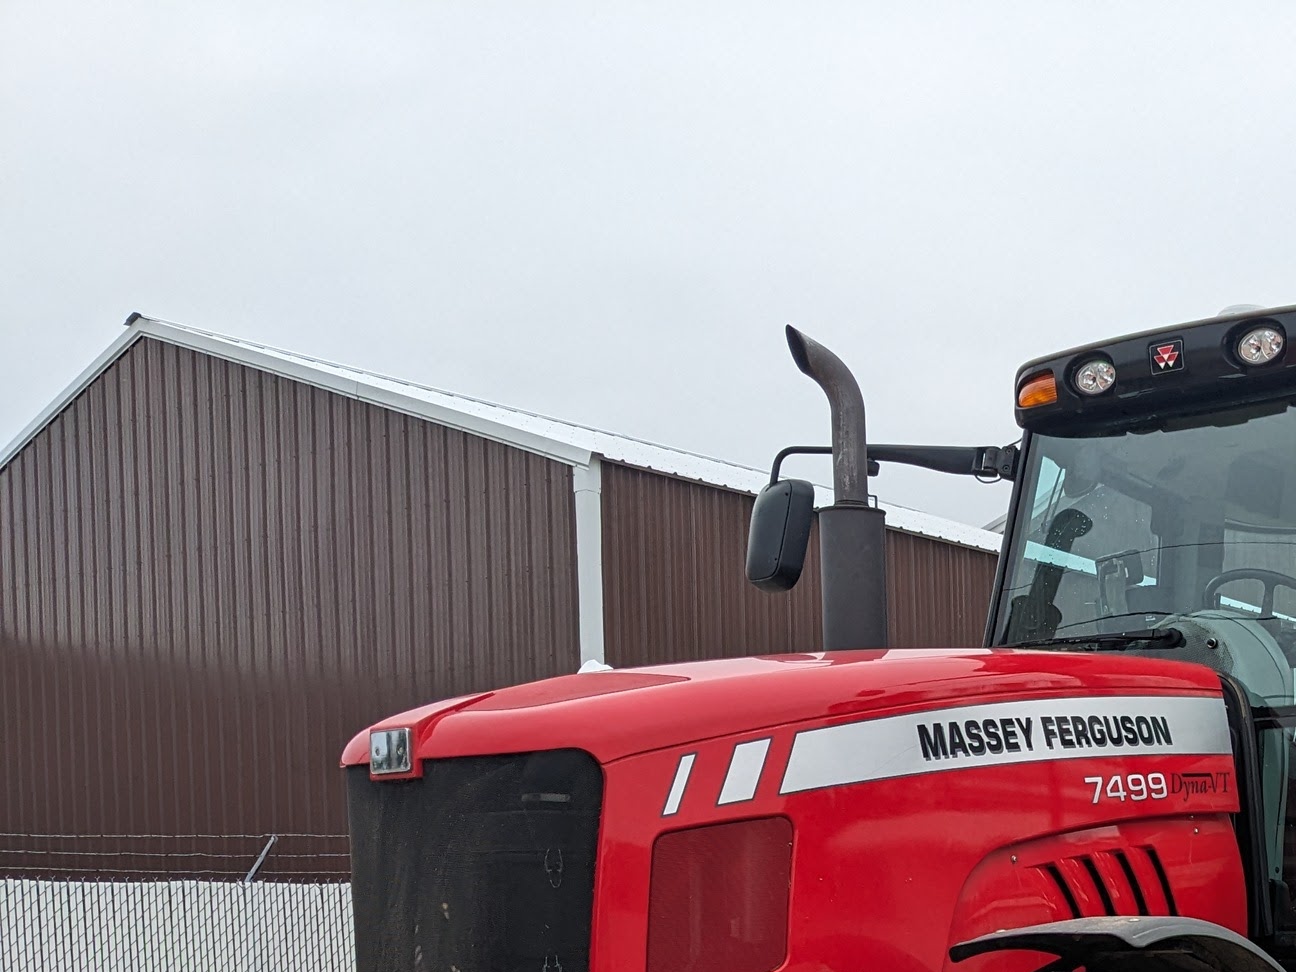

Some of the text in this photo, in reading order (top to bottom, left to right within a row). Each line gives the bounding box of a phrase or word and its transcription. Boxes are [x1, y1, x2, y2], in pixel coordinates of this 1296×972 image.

[917, 715, 1174, 761] MASSEY FERGUSON
[1084, 773, 1167, 804] 7499
